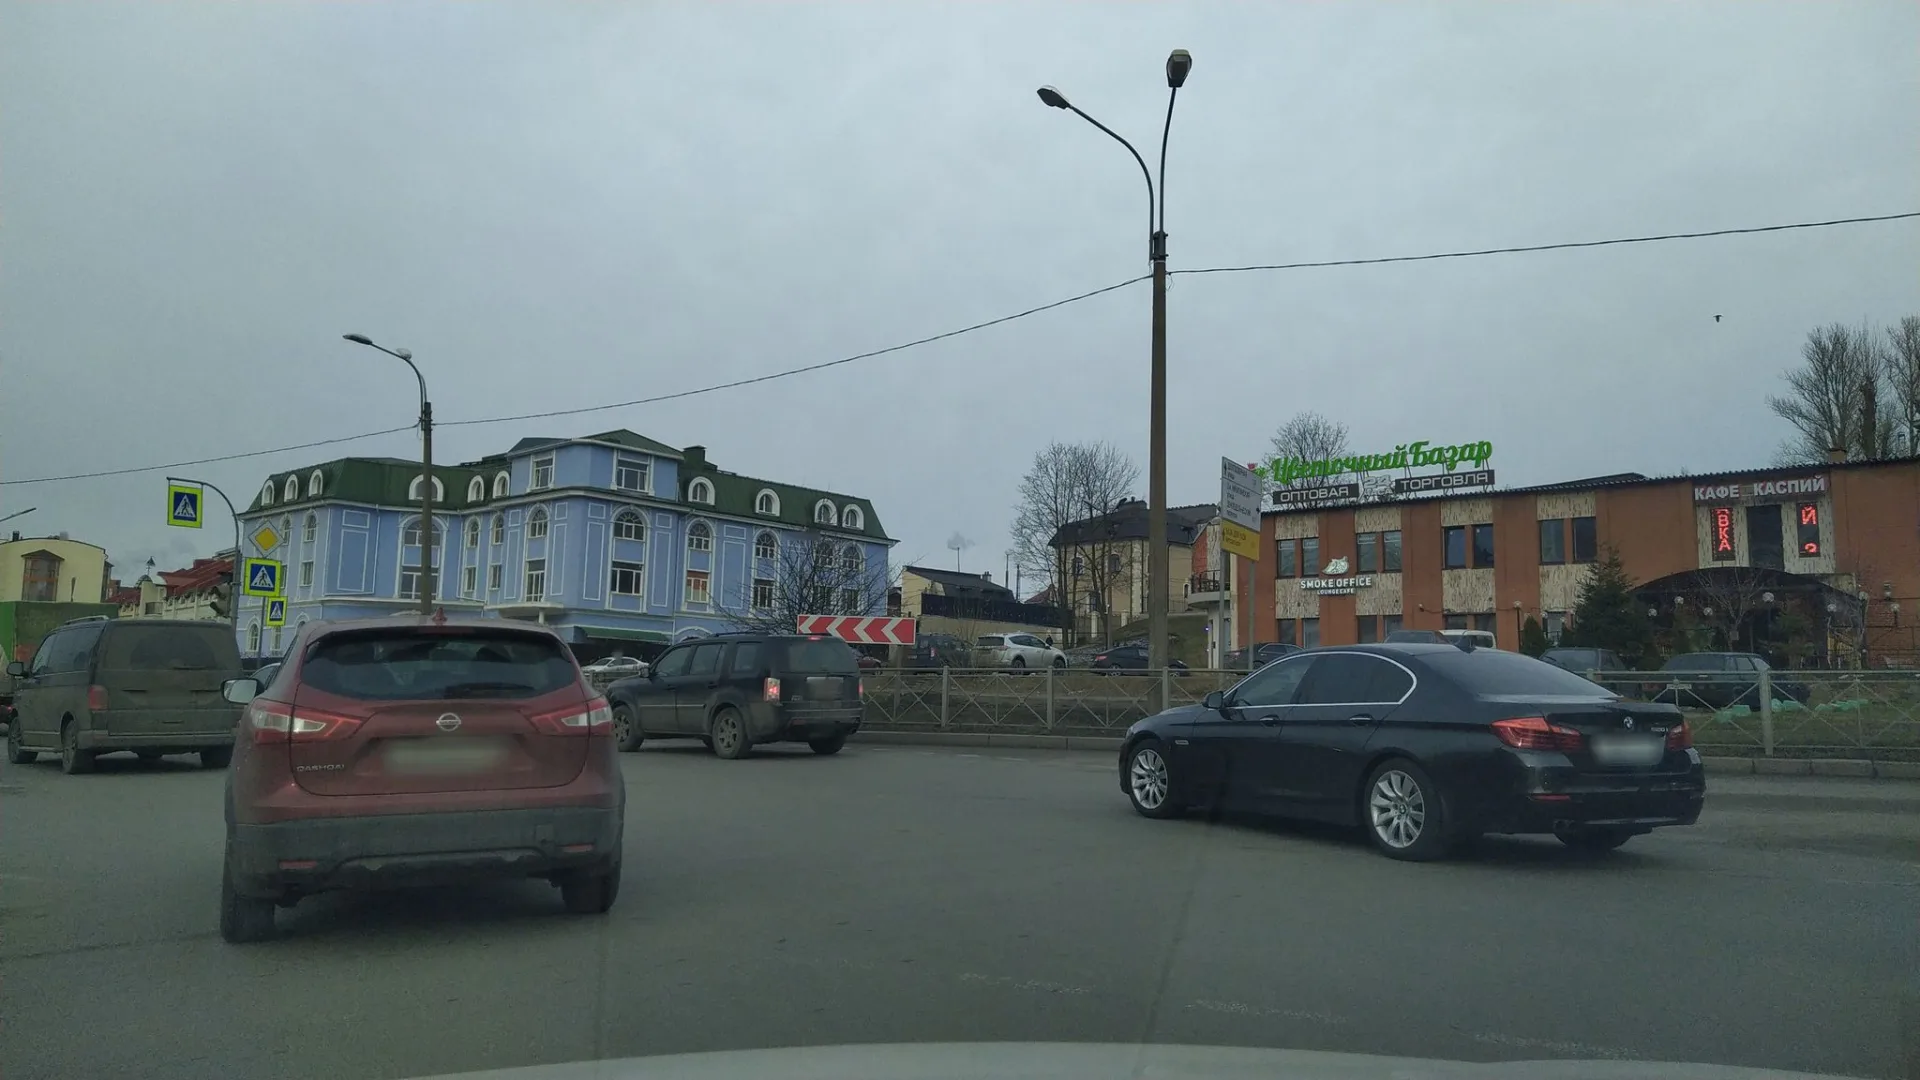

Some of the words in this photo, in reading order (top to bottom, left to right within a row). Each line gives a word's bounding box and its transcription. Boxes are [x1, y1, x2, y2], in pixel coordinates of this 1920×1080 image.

[1272, 444, 1407, 485] Цветочный
[1409, 441, 1492, 471] Базар
[1401, 472, 1488, 491] ТОРГОВЛЯ
[1694, 484, 1740, 501] КАФЕ
[1753, 475, 1826, 497] КАСПИЙ
[1280, 486, 1349, 502] ОПТОВАЯ
[1300, 579, 1334, 589] SMOKE
[1336, 577, 1372, 588] OFFICE
